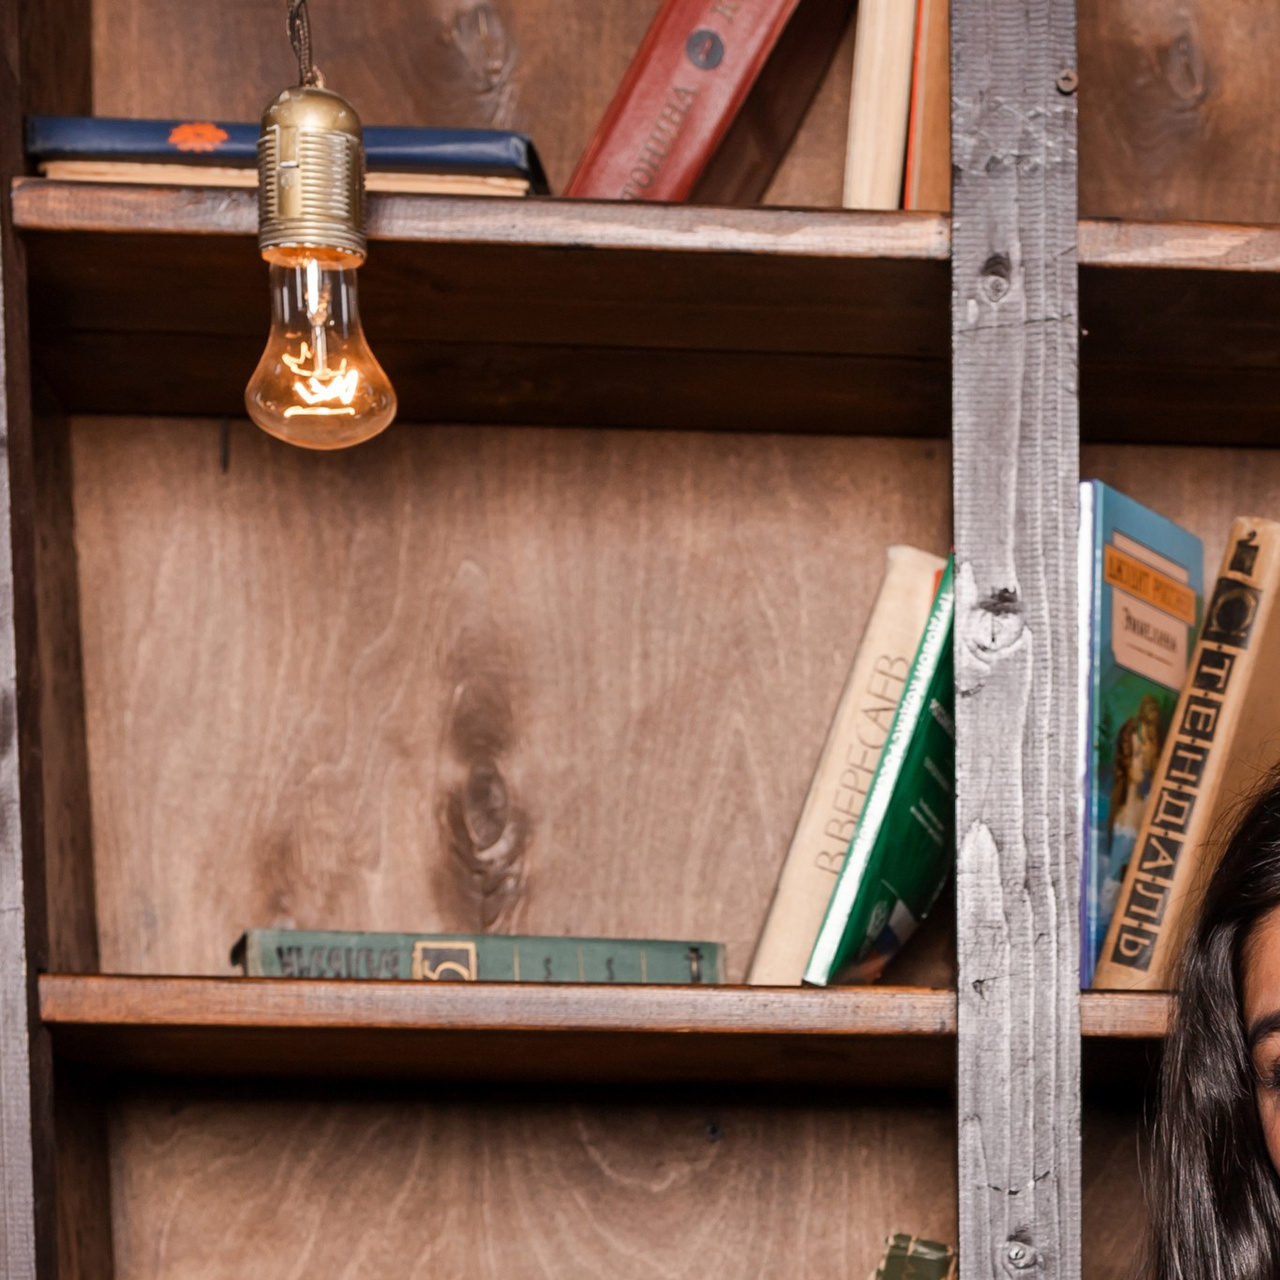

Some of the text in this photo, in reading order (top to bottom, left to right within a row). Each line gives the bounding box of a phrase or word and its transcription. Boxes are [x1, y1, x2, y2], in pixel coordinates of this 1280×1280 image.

[622, 82, 700, 201] ТОНИНА
[824, 648, 913, 845] ВЕРЕСАЕВ
[1112, 579, 1262, 970] СТЕНДАЛЬ
